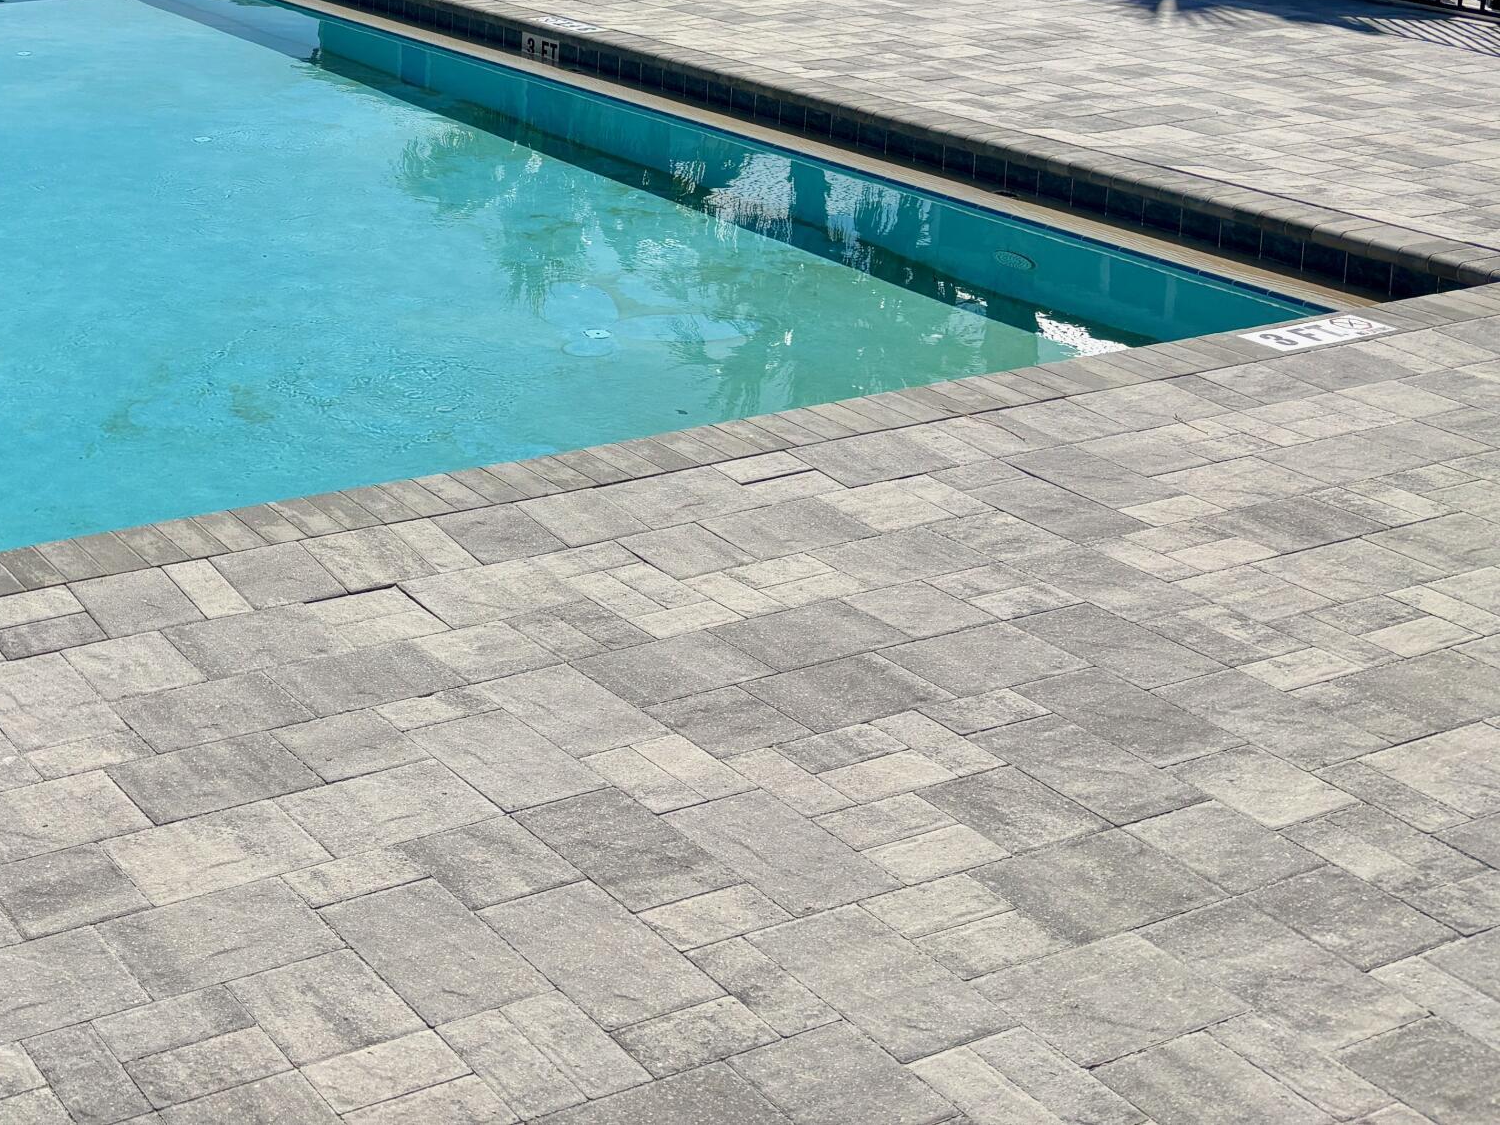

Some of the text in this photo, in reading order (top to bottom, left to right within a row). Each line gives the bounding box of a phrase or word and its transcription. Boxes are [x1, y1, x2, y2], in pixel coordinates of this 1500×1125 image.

[527, 37, 558, 60] 3 FT
[1259, 333, 1299, 346] 3
